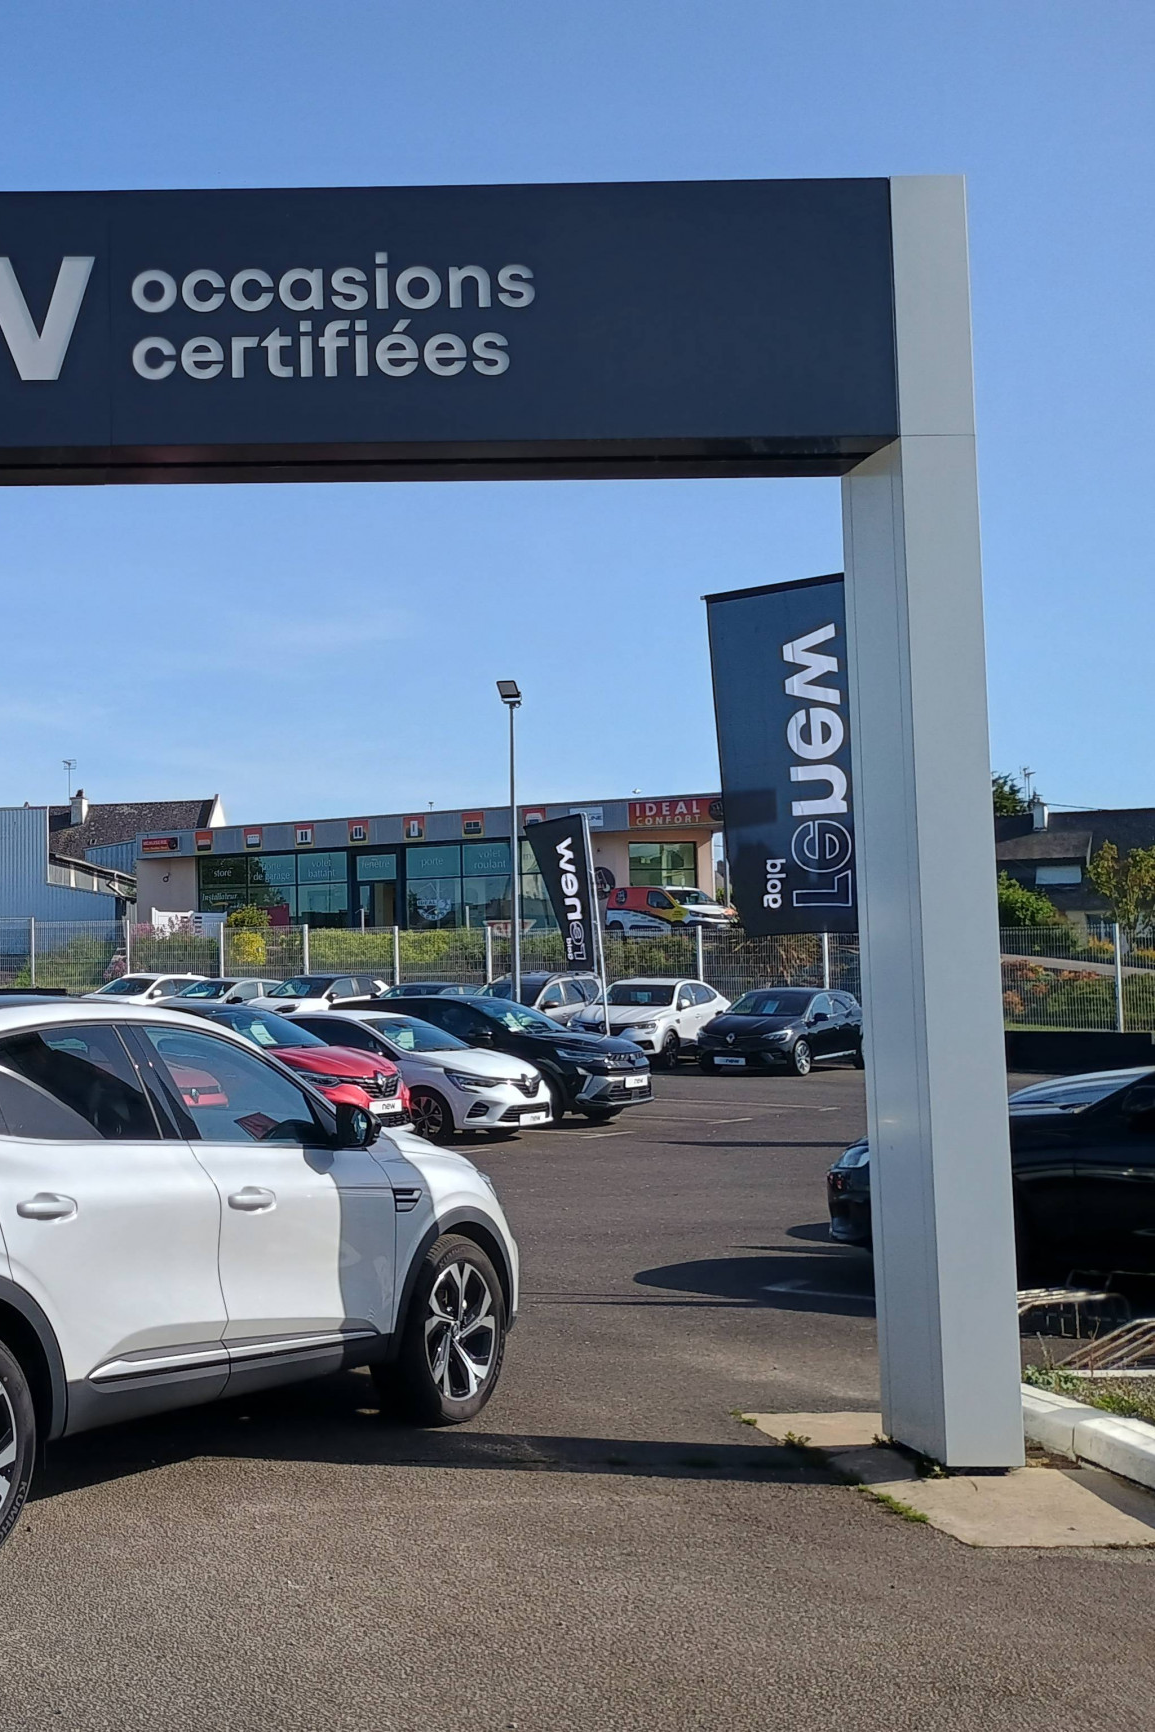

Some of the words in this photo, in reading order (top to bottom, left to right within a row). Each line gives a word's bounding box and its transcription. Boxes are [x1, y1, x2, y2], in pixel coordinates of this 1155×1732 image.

[131, 251, 536, 313] occasions
[131, 318, 511, 381] certifiées
[635, 800, 701, 816] IDEAL
[636, 814, 701, 826] CONFORT
[478, 850, 501, 859] volet
[311, 859, 333, 868] volet
[421, 858, 444, 868] porte
[474, 860, 506, 869] roulant
[213, 869, 232, 877] store
[253, 872, 264, 881] de
[265, 872, 291, 883] garage
[307, 868, 336, 878] battant
